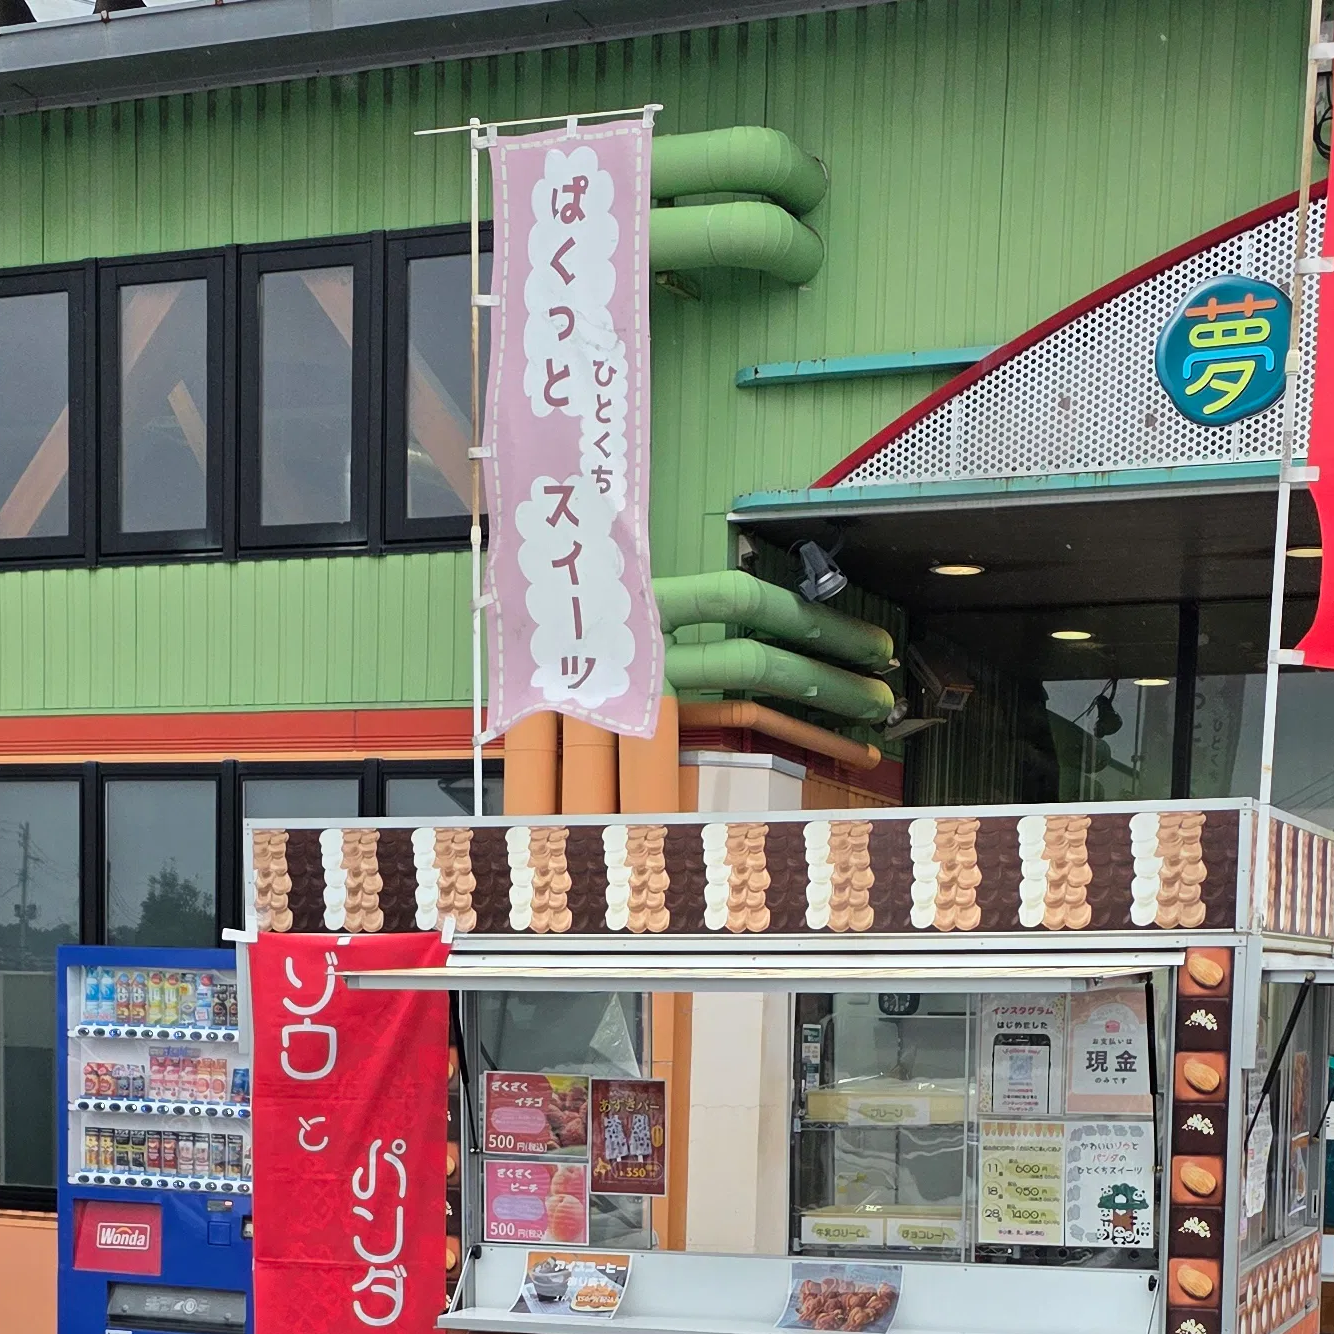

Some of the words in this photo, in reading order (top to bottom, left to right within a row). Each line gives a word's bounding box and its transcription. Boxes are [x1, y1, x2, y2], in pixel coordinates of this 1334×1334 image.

[541, 174, 590, 409] ぱくっと
[1183, 293, 1278, 415] 夢
[590, 357, 618, 496] ひとくち
[542, 484, 596, 691] スイーツ
[991, 1006, 1054, 1016] インスタグラム
[997, 1021, 1048, 1030] はじめました
[1085, 1050, 1138, 1073] 現金
[490, 1081, 529, 1093] ざくざく
[514, 1097, 545, 1108] イチゴ
[598, 1098, 660, 1113] あずきバー
[488, 1134, 515, 1149] 500
[1080, 1142, 1139, 1150] かわいいゾウと
[1092, 1154, 1127, 1163] パンダの
[497, 1168, 532, 1179] ざくざく
[1077, 1166, 1143, 1175] ひとくちスイーツ
[510, 1183, 539, 1193] ピーチ
[490, 1221, 516, 1236] 500
[99, 1226, 147, 1247] Wonda
[554, 1260, 627, 1274] アイスコーヒー
